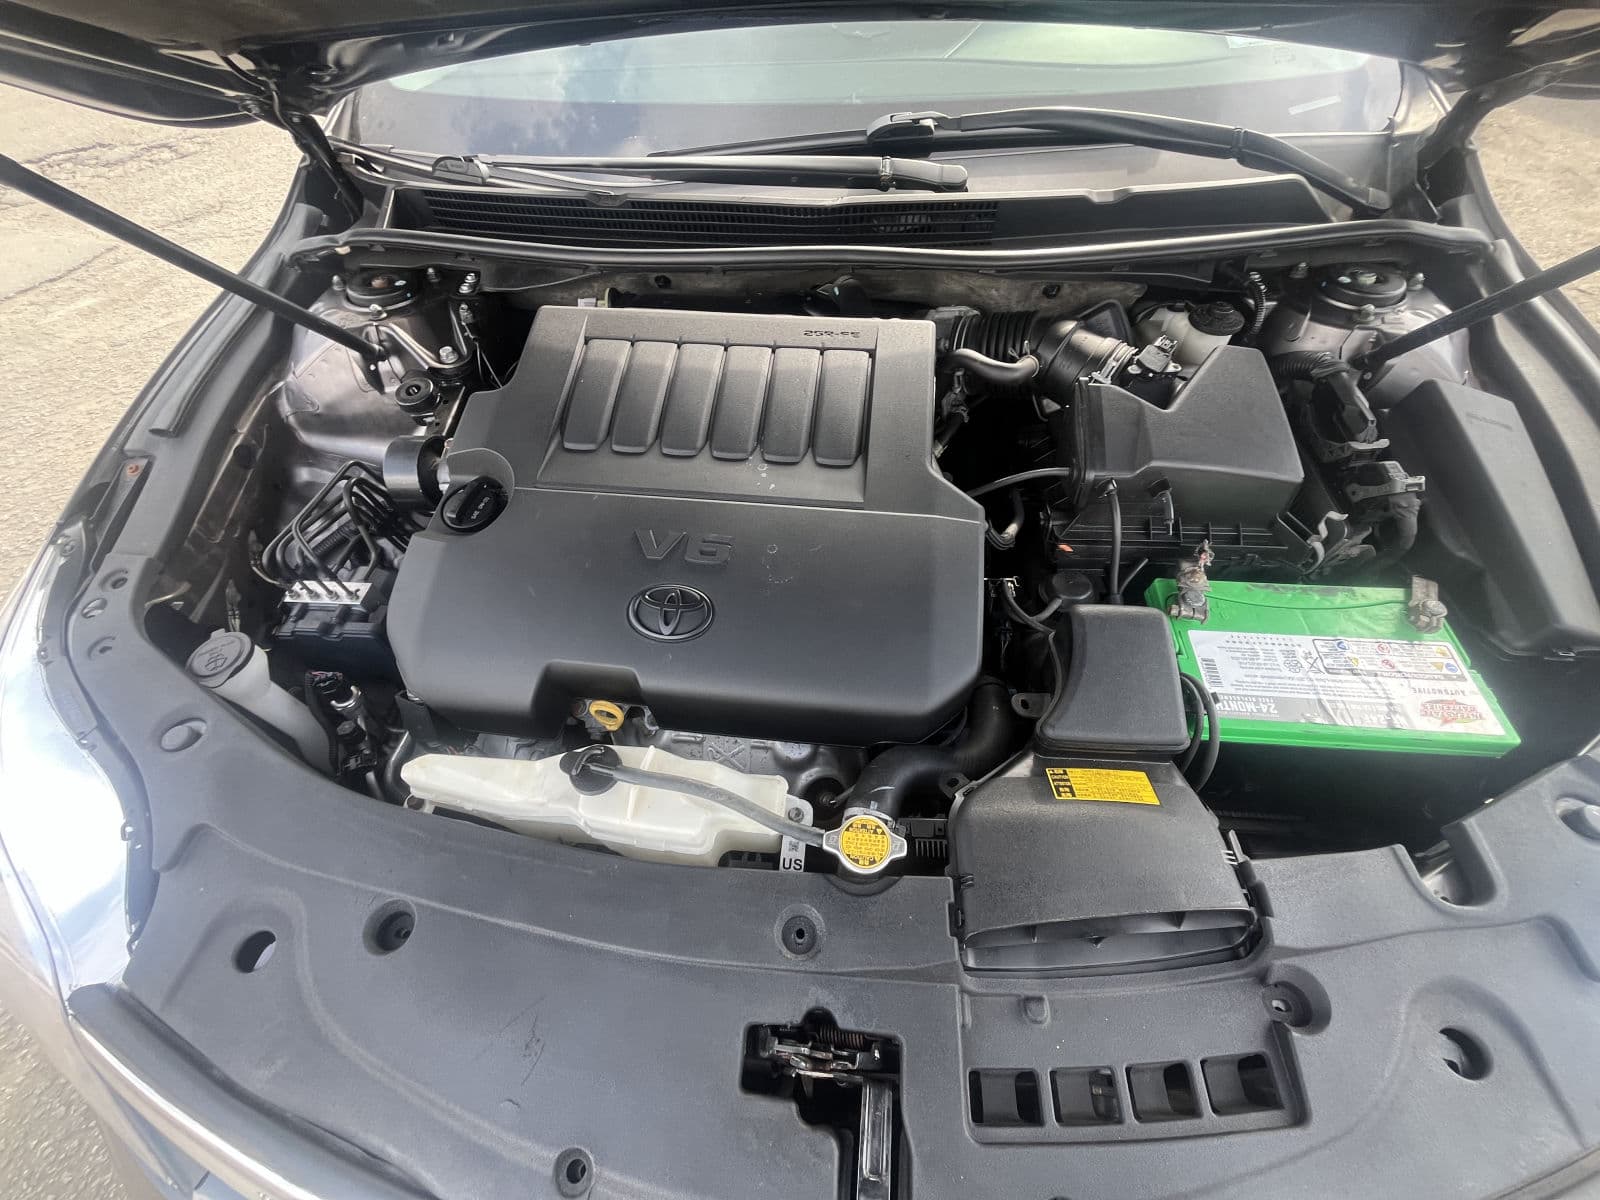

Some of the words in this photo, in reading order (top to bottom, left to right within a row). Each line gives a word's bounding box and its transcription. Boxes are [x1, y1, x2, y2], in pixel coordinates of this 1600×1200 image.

[633, 528, 737, 566] V6
[1410, 687, 1466, 697] AUTOMOTIVE
[782, 857, 803, 871] US
